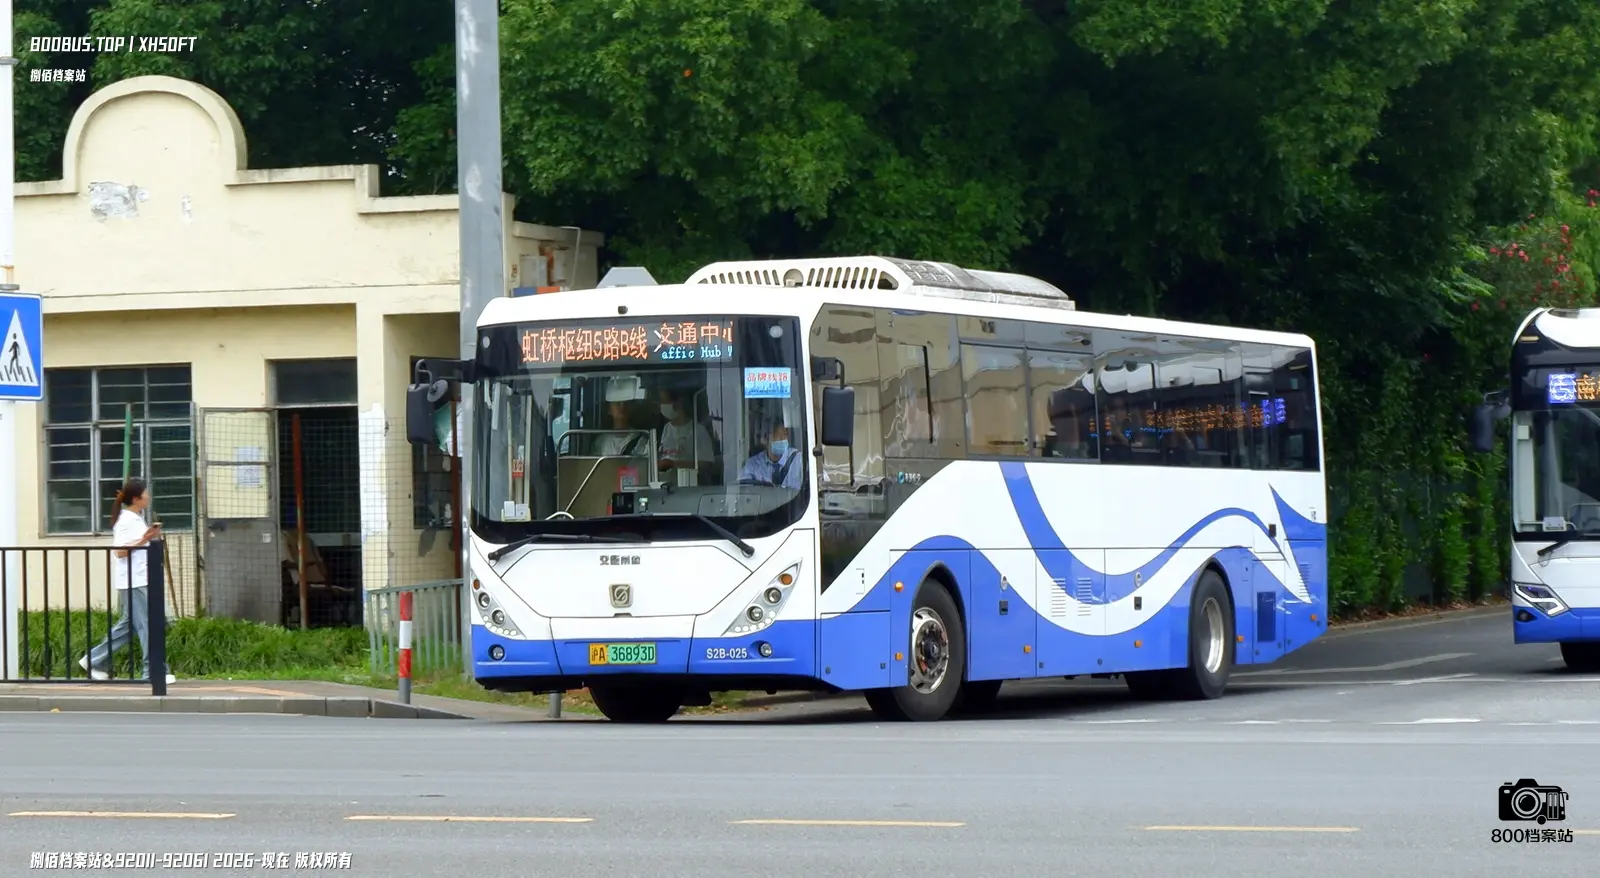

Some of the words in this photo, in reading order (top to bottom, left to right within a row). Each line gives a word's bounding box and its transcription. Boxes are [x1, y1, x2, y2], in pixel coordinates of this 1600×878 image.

[521, 326, 648, 363] 虹桥枢纽5路B线
[700, 344, 722, 358] Hub
[611, 646, 655, 662] 36893D
[706, 648, 747, 659] S2B-025
